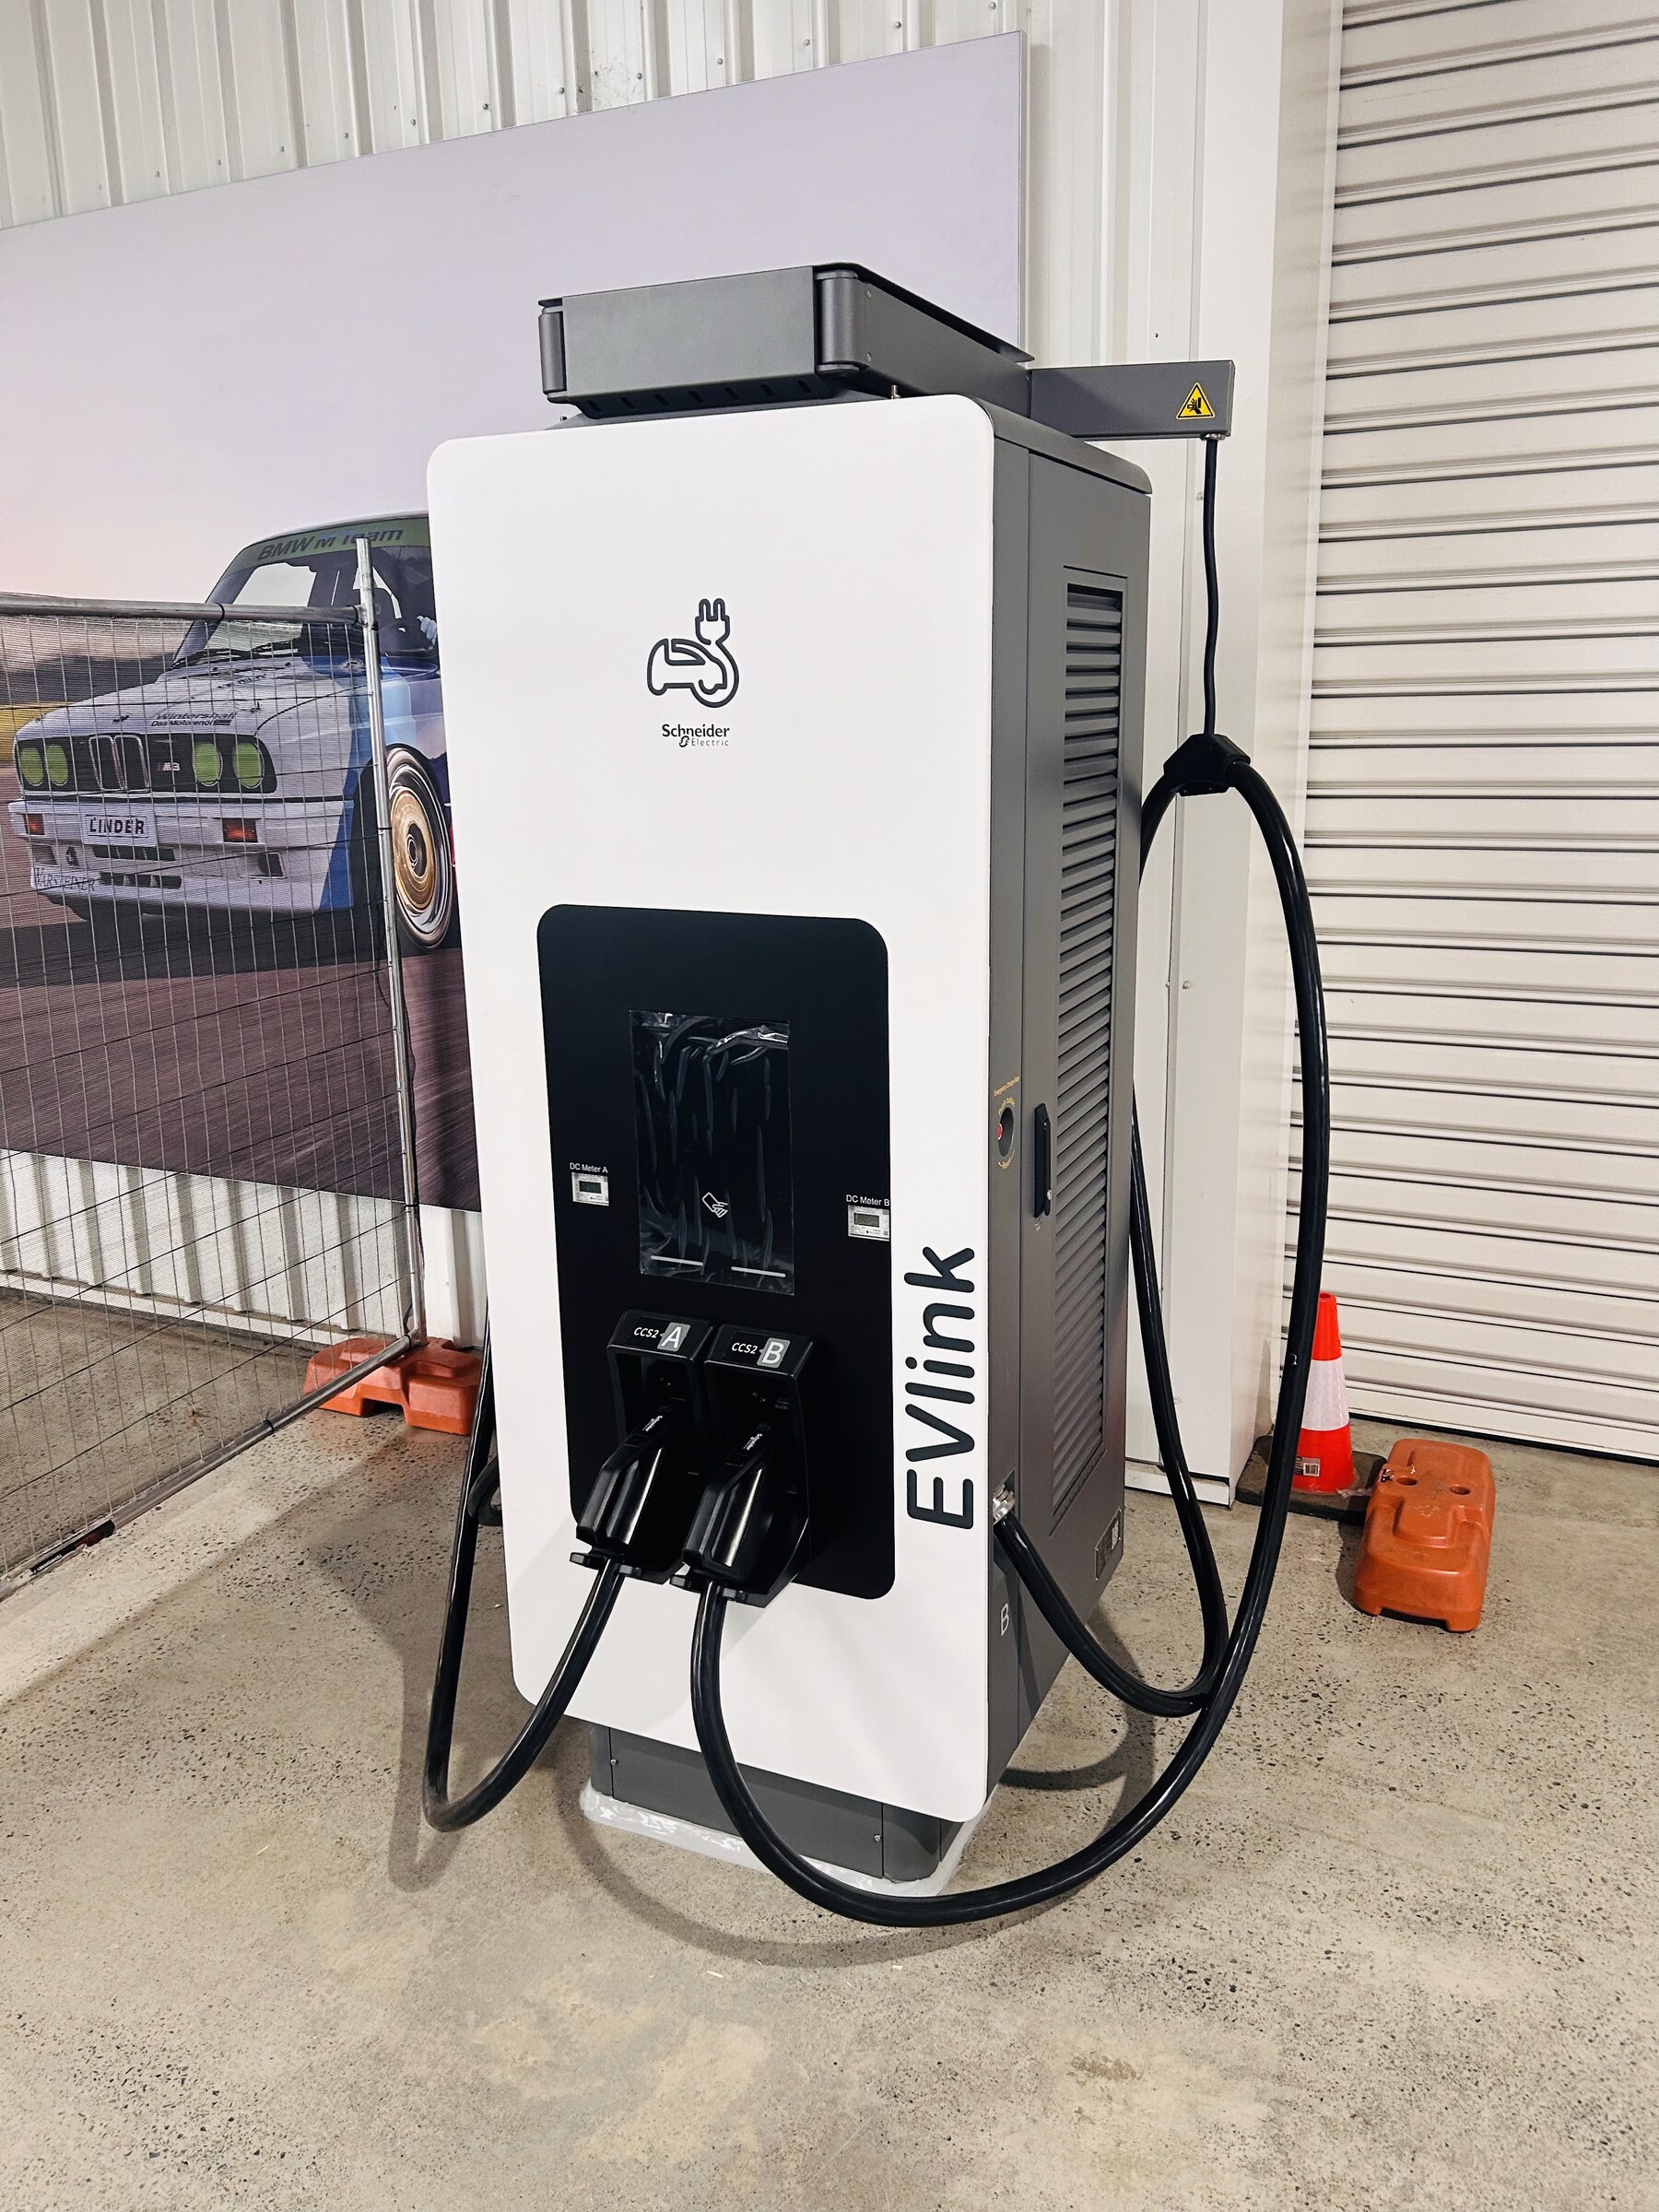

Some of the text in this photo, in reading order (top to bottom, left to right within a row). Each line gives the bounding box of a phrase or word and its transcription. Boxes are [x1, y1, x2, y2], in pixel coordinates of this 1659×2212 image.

[257, 535, 315, 561] BMW
[314, 533, 336, 549] M
[662, 724, 730, 738] Schneider
[691, 738, 729, 747] Electric
[89, 818, 145, 835] LINDER
[570, 1162, 581, 1171] DC
[582, 1163, 602, 1172] Meter
[846, 1194, 889, 1206] DC Meter B
[633, 1325, 682, 1348] CCS2 A
[731, 1341, 784, 1364] CCS2 B
[904, 1246, 975, 1530] EVlink
[1001, 1602, 1009, 1636] B
